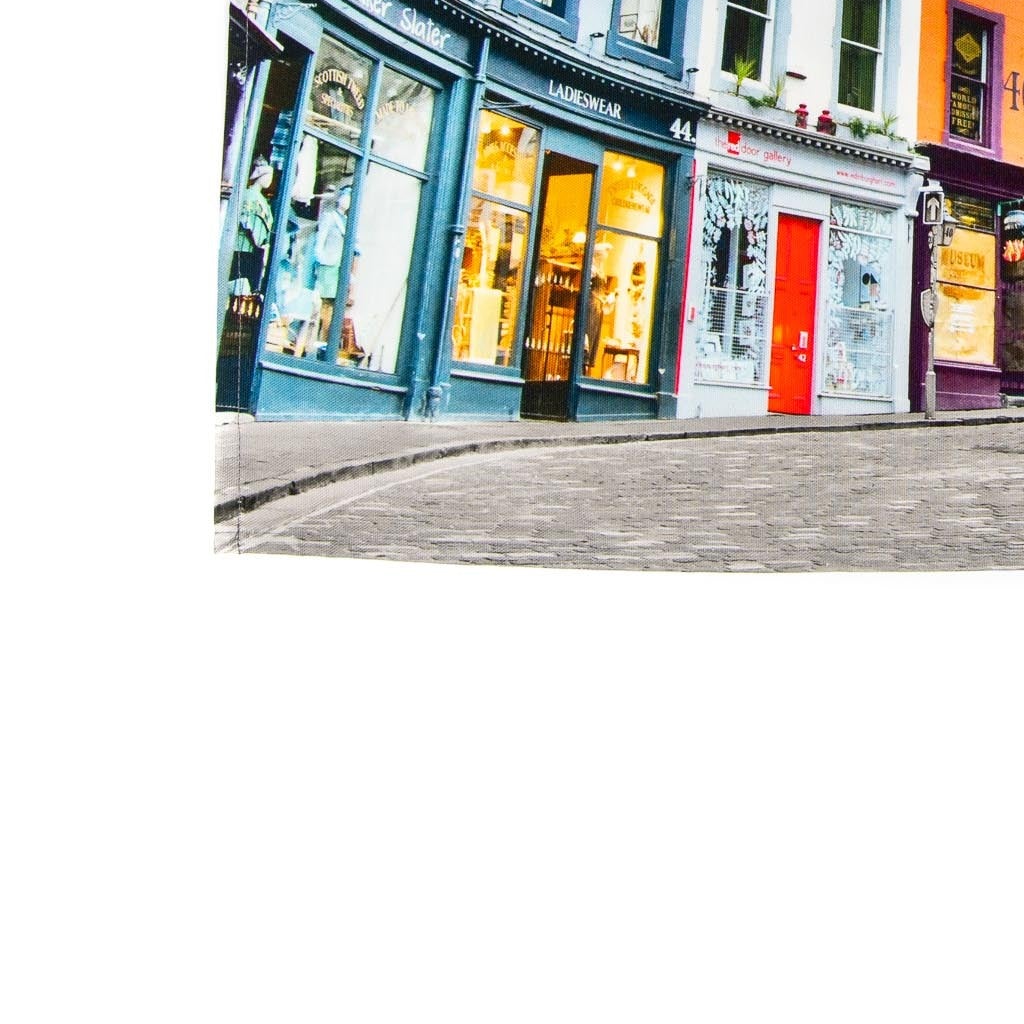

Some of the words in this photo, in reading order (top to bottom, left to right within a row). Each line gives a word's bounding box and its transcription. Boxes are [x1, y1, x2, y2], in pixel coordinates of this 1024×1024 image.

[400, 7, 450, 50] Slater
[549, 79, 621, 120] LADIESWEAR
[740, 141, 760, 156] door
[763, 149, 793, 167] gallery
